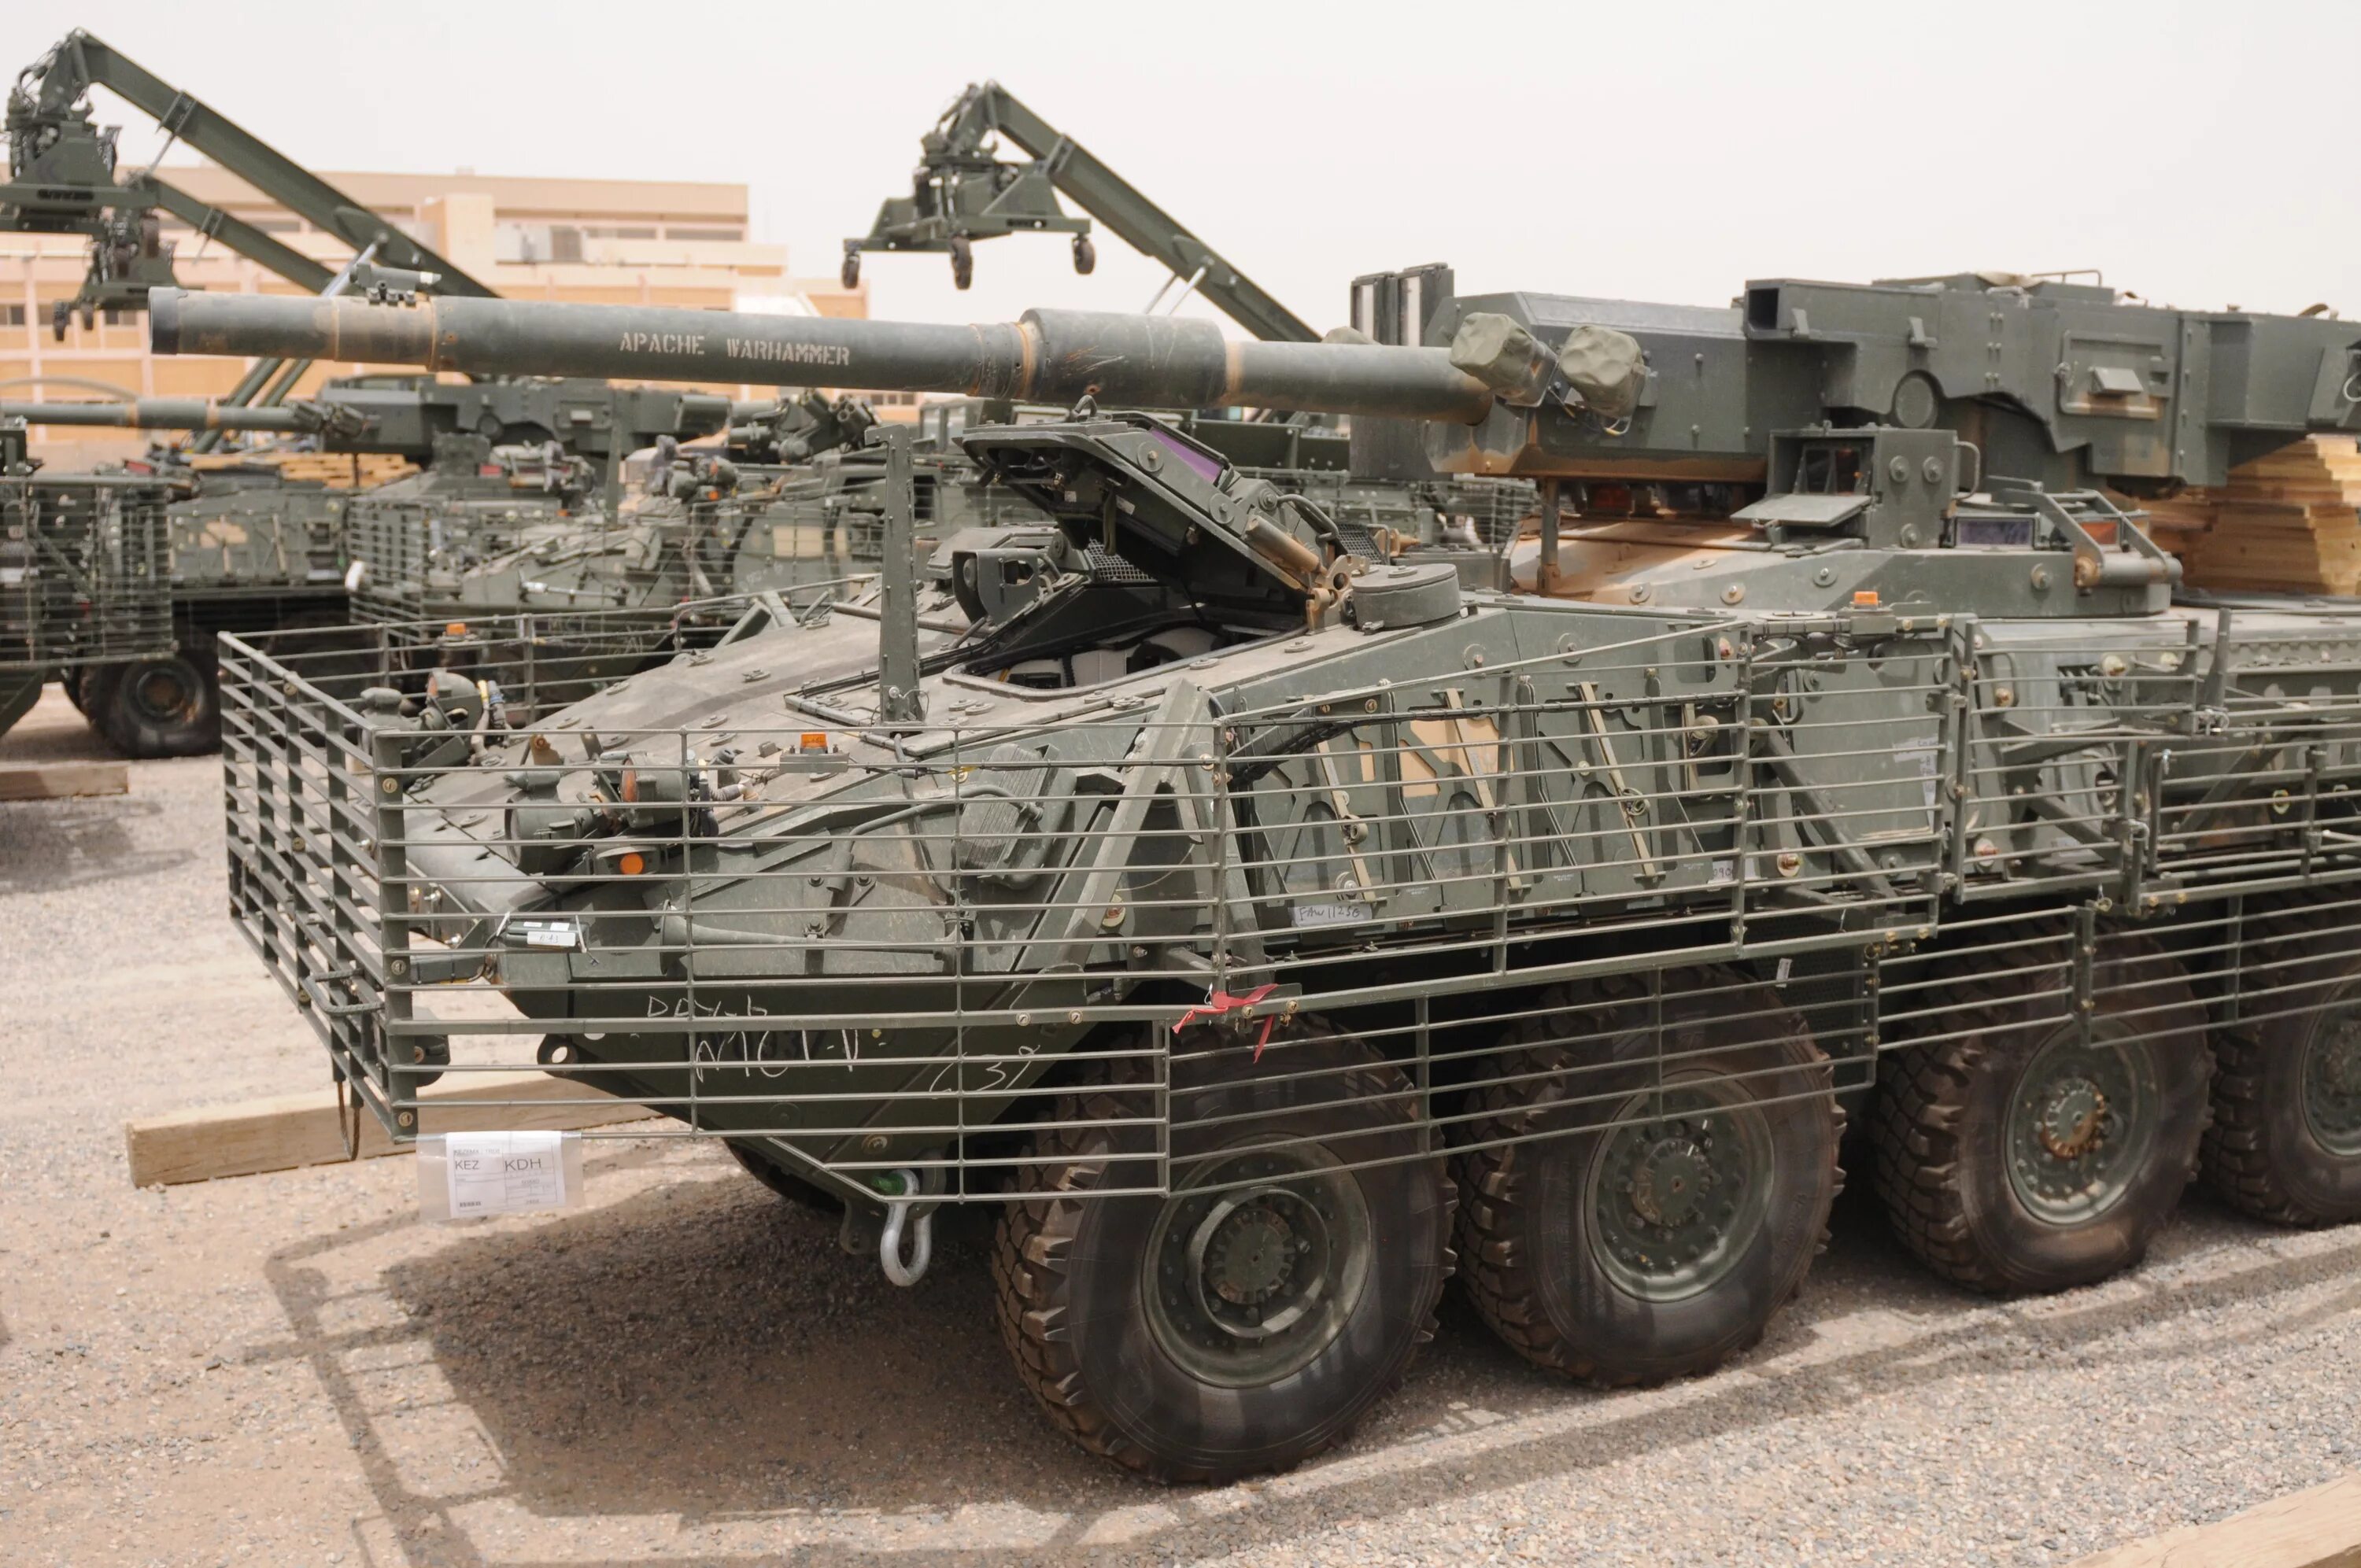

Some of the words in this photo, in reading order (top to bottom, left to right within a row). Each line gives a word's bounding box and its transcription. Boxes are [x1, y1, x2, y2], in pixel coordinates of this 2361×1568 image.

[619, 332, 705, 355] APACHE
[726, 338, 850, 366] WARHAMMER
[455, 1160, 479, 1171] KEZ
[504, 1158, 541, 1171] KDH
